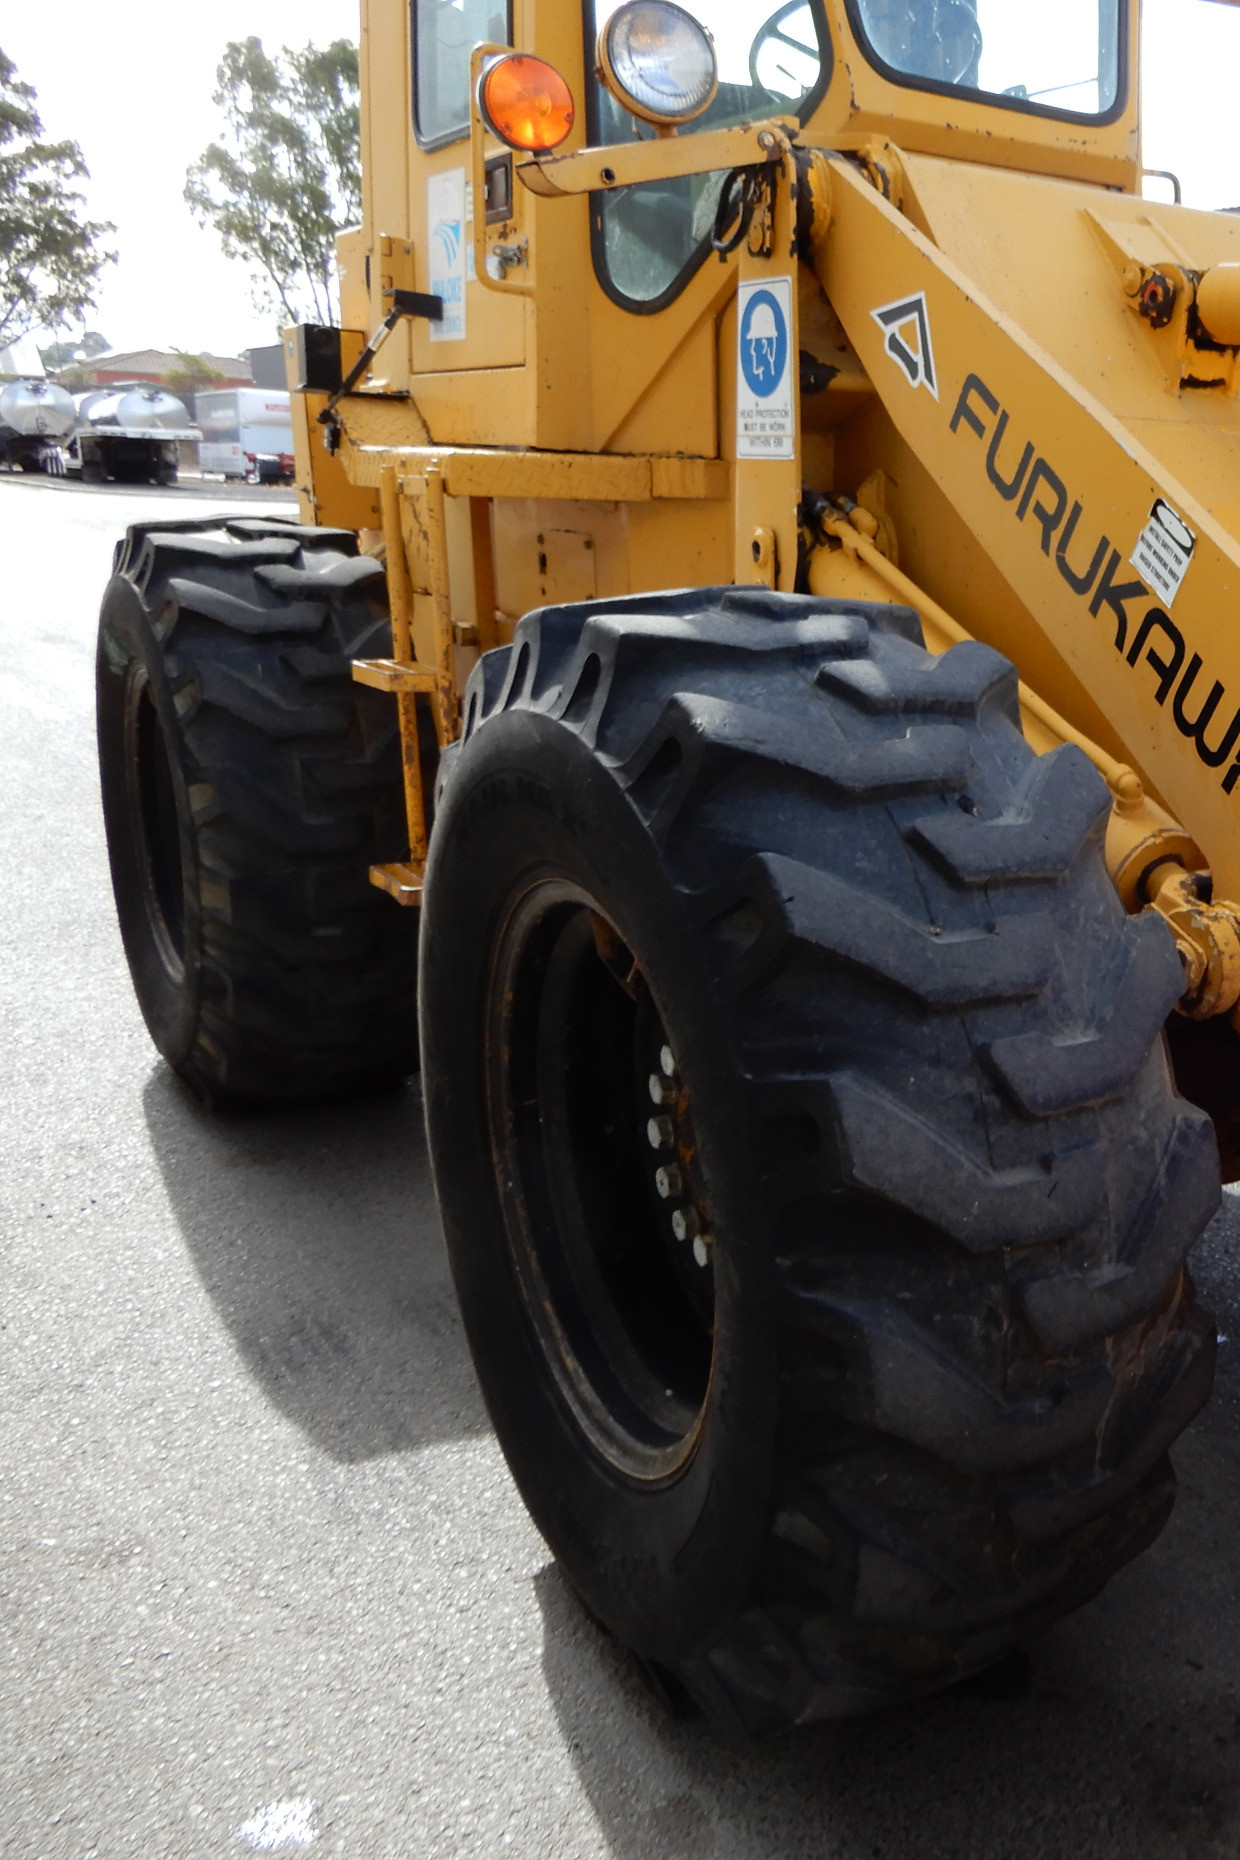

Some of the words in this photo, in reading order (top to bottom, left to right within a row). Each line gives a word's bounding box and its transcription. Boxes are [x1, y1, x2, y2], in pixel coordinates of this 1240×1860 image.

[740, 409, 754, 419] HEAD
[755, 409, 790, 419] PROTECTION
[760, 422, 767, 432] BE
[1161, 539, 1174, 557] SAFETY
[1152, 548, 1169, 571] WORKING
[1167, 566, 1180, 584] UNDER
[1151, 565, 1171, 592] STRUCTURE
